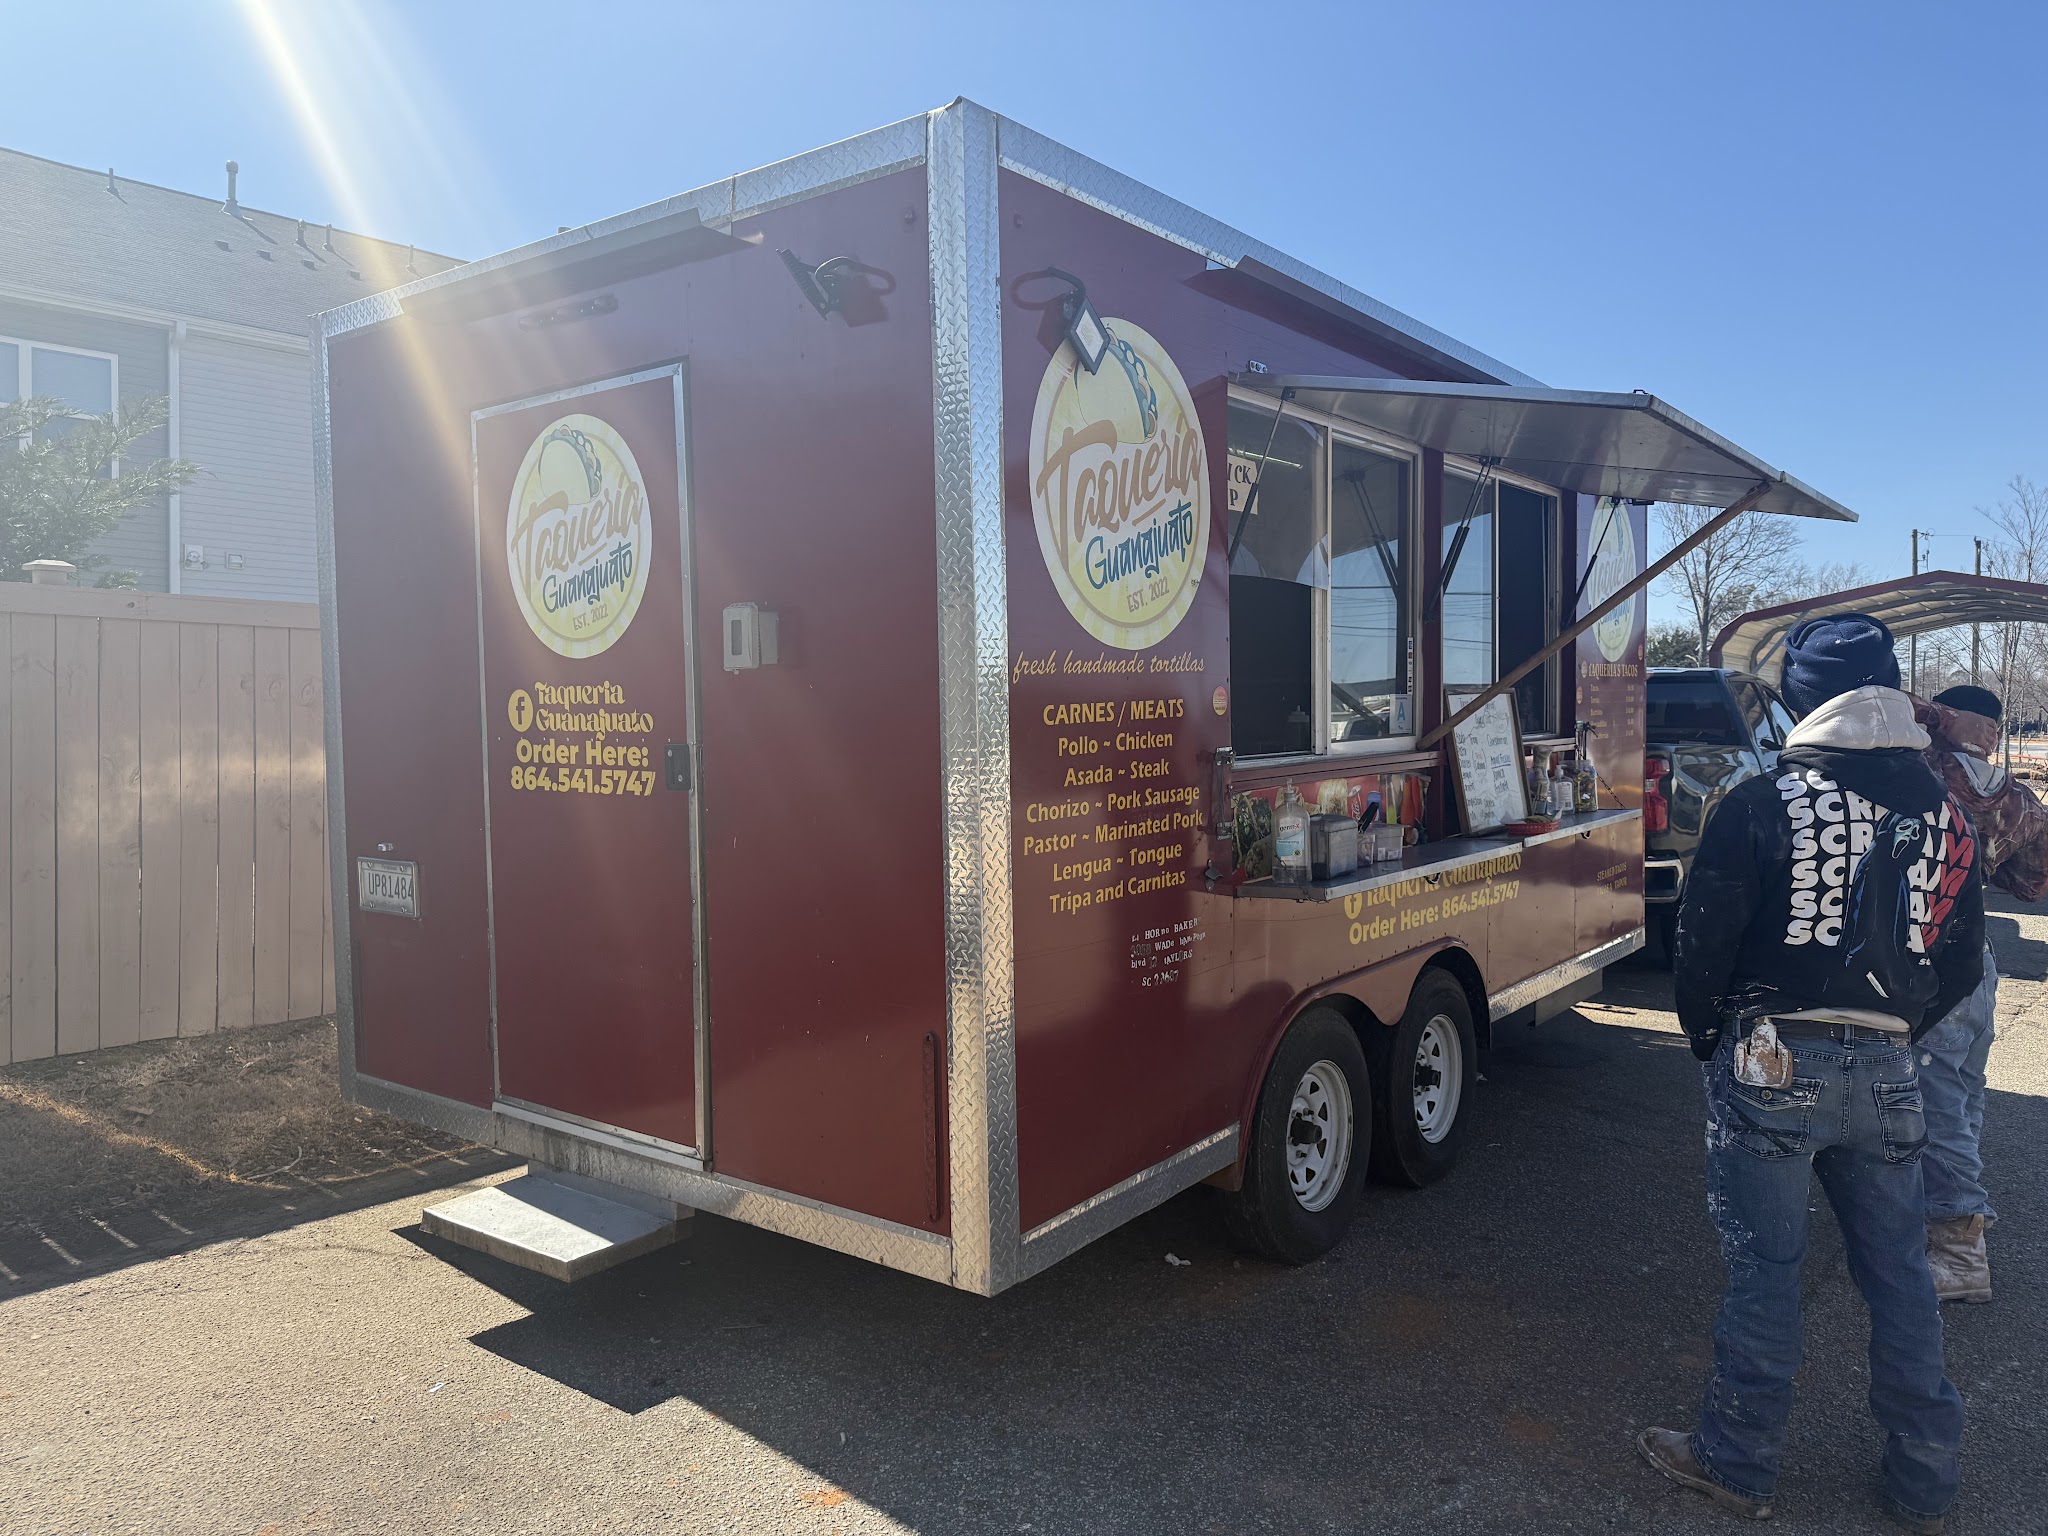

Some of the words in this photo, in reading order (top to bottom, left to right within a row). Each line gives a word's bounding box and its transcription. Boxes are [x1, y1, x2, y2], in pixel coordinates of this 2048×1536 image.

[1227, 462, 1252, 485] ICK
[1036, 412, 1202, 573] Taqueria
[1229, 487, 1239, 506] P
[511, 470, 643, 602] Taqueria
[1086, 499, 1193, 590] Guanajuato
[543, 541, 633, 614] Guanajuato
[1126, 586, 1148, 613] EST.
[1149, 576, 1170, 602] 2022
[572, 613, 590, 632] EST.
[591, 603, 609, 624] 2022
[1012, 650, 1057, 685] fresh
[1063, 650, 1144, 674] handmade
[1150, 651, 1205, 673] tortillas
[1622, 664, 1638, 677] TACOS
[534, 680, 625, 712] Taqueria
[1397, 702, 1406, 721] A
[535, 708, 654, 741] Guanajuato
[1043, 701, 1115, 726] CARNES
[1130, 699, 1184, 721] MEATS
[516, 738, 579, 764] Order
[585, 740, 649, 767] Here:
[1058, 735, 1099, 757] Pollo
[1115, 730, 1173, 751] Chicken
[511, 765, 656, 796] 864.541.5747
[1063, 765, 1113, 787] Asada
[1130, 758, 1170, 779] Steak
[1026, 799, 1090, 823] Chorizo
[1107, 790, 1142, 812] Pork
[1144, 786, 1200, 807] Sausage
[1023, 833, 1077, 856] Pastor
[1095, 814, 1170, 844] Marinated
[1173, 809, 1203, 830] Pork
[1053, 857, 1112, 882] Lengua
[1129, 843, 1182, 867] Tongue
[368, 872, 413, 900] UP81484
[1049, 891, 1091, 915] Tripa
[1095, 880, 1124, 904] and
[1127, 870, 1186, 895] Carnitas
[1349, 915, 1397, 945] Order
[1401, 904, 1439, 931] Here:
[1442, 880, 1520, 919] 864.541.5747
[1141, 976, 1152, 987] SC
